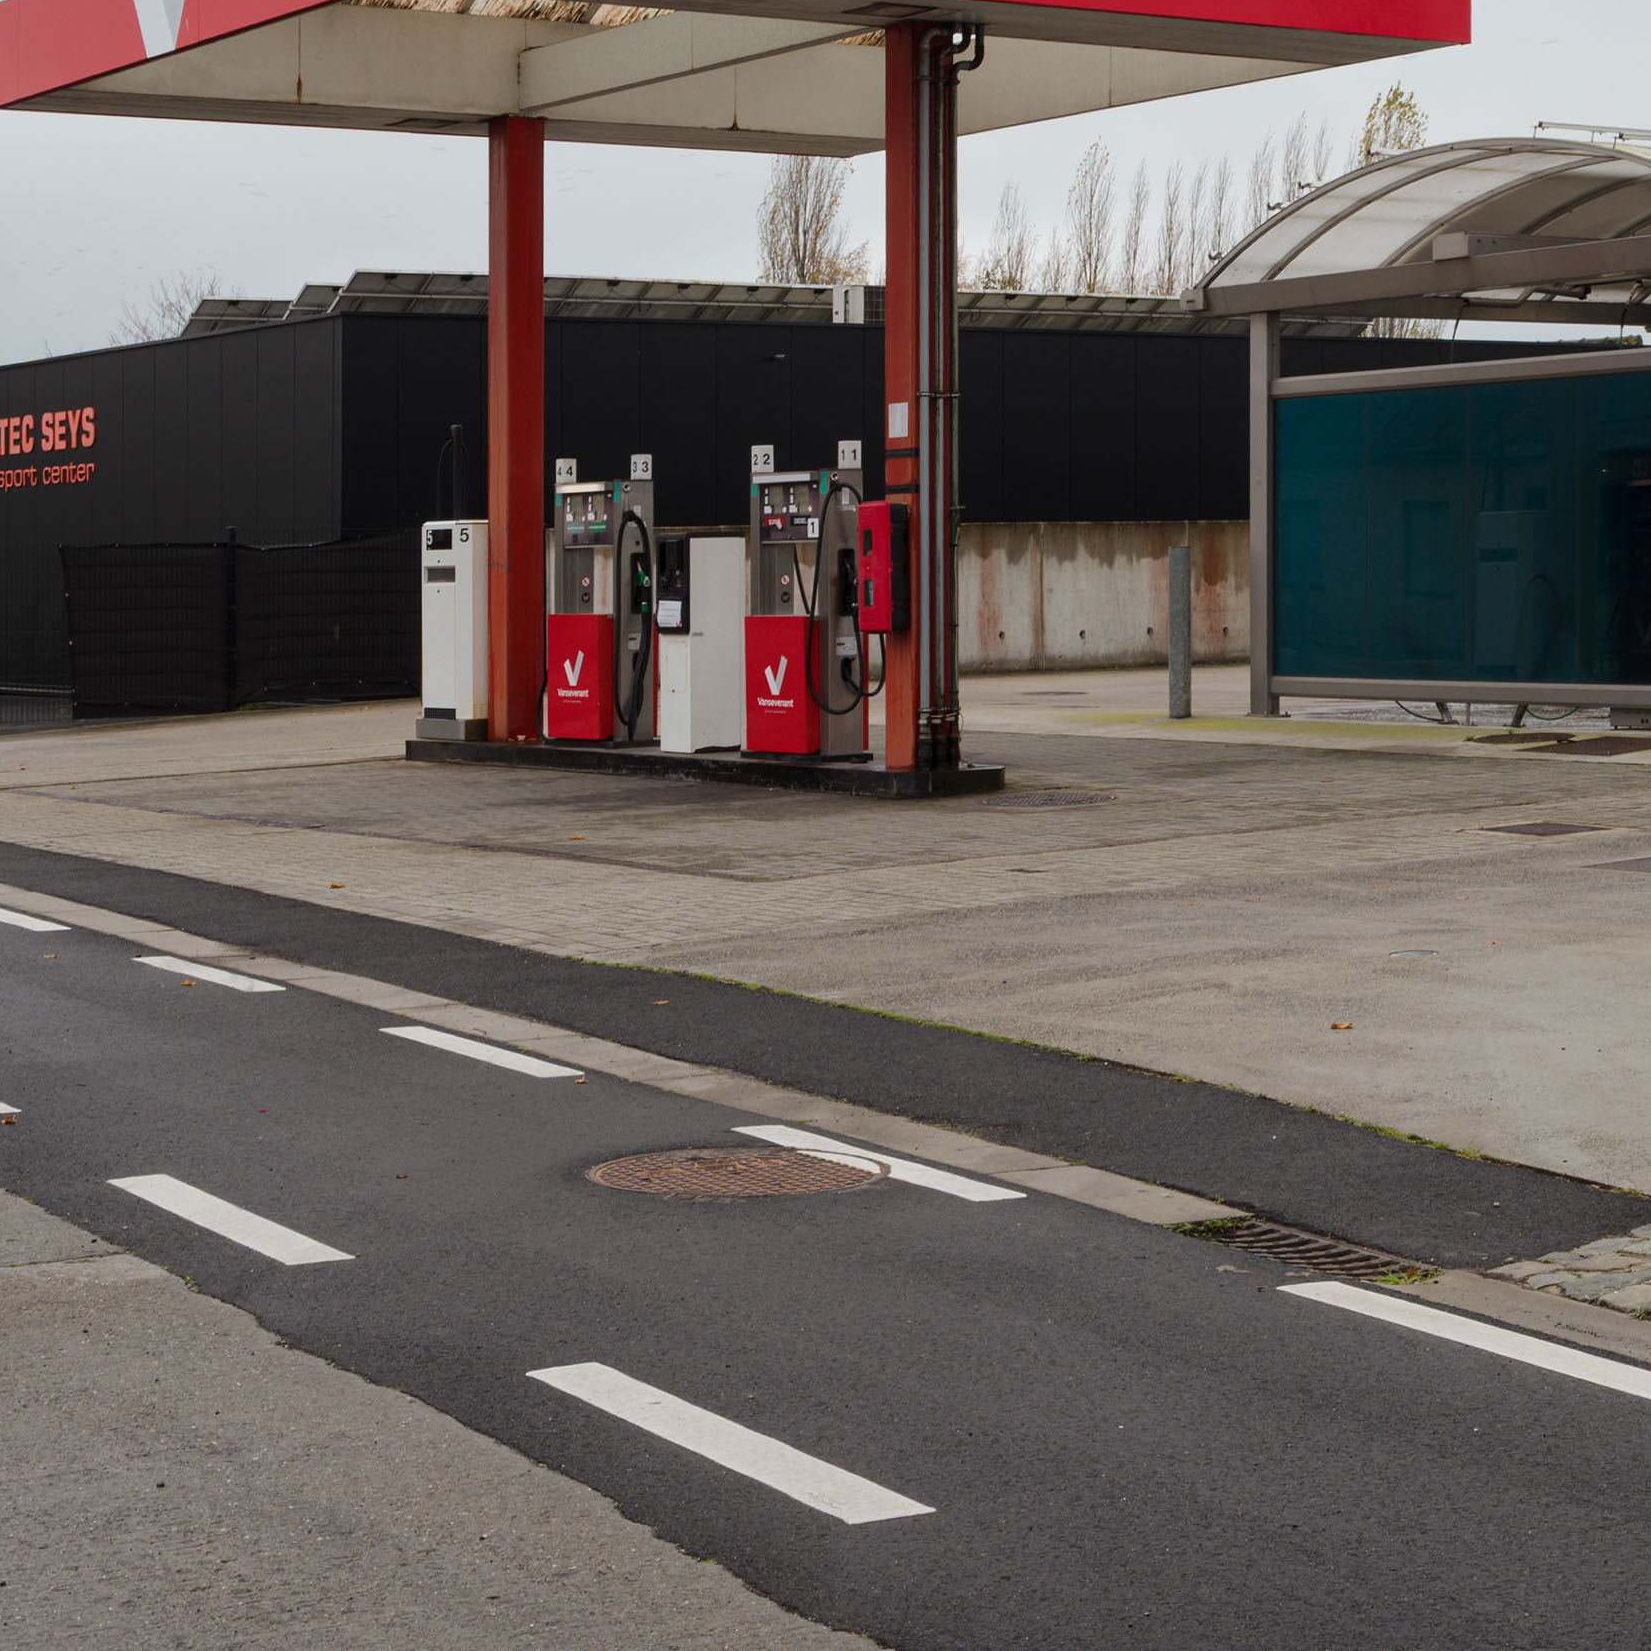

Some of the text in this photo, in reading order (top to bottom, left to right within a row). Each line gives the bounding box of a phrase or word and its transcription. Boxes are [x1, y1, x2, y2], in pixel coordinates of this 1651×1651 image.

[41, 406, 96, 451] SEYS
[753, 454, 759, 465] 2
[763, 453, 771, 465] 2
[851, 449, 857, 461] 1
[566, 466, 573, 476] 4
[632, 461, 638, 473] 3
[642, 461, 649, 472] 3
[42, 462, 96, 485] center
[810, 521, 815, 534] 1
[426, 530, 433, 545] 5
[460, 528, 469, 542] 5
